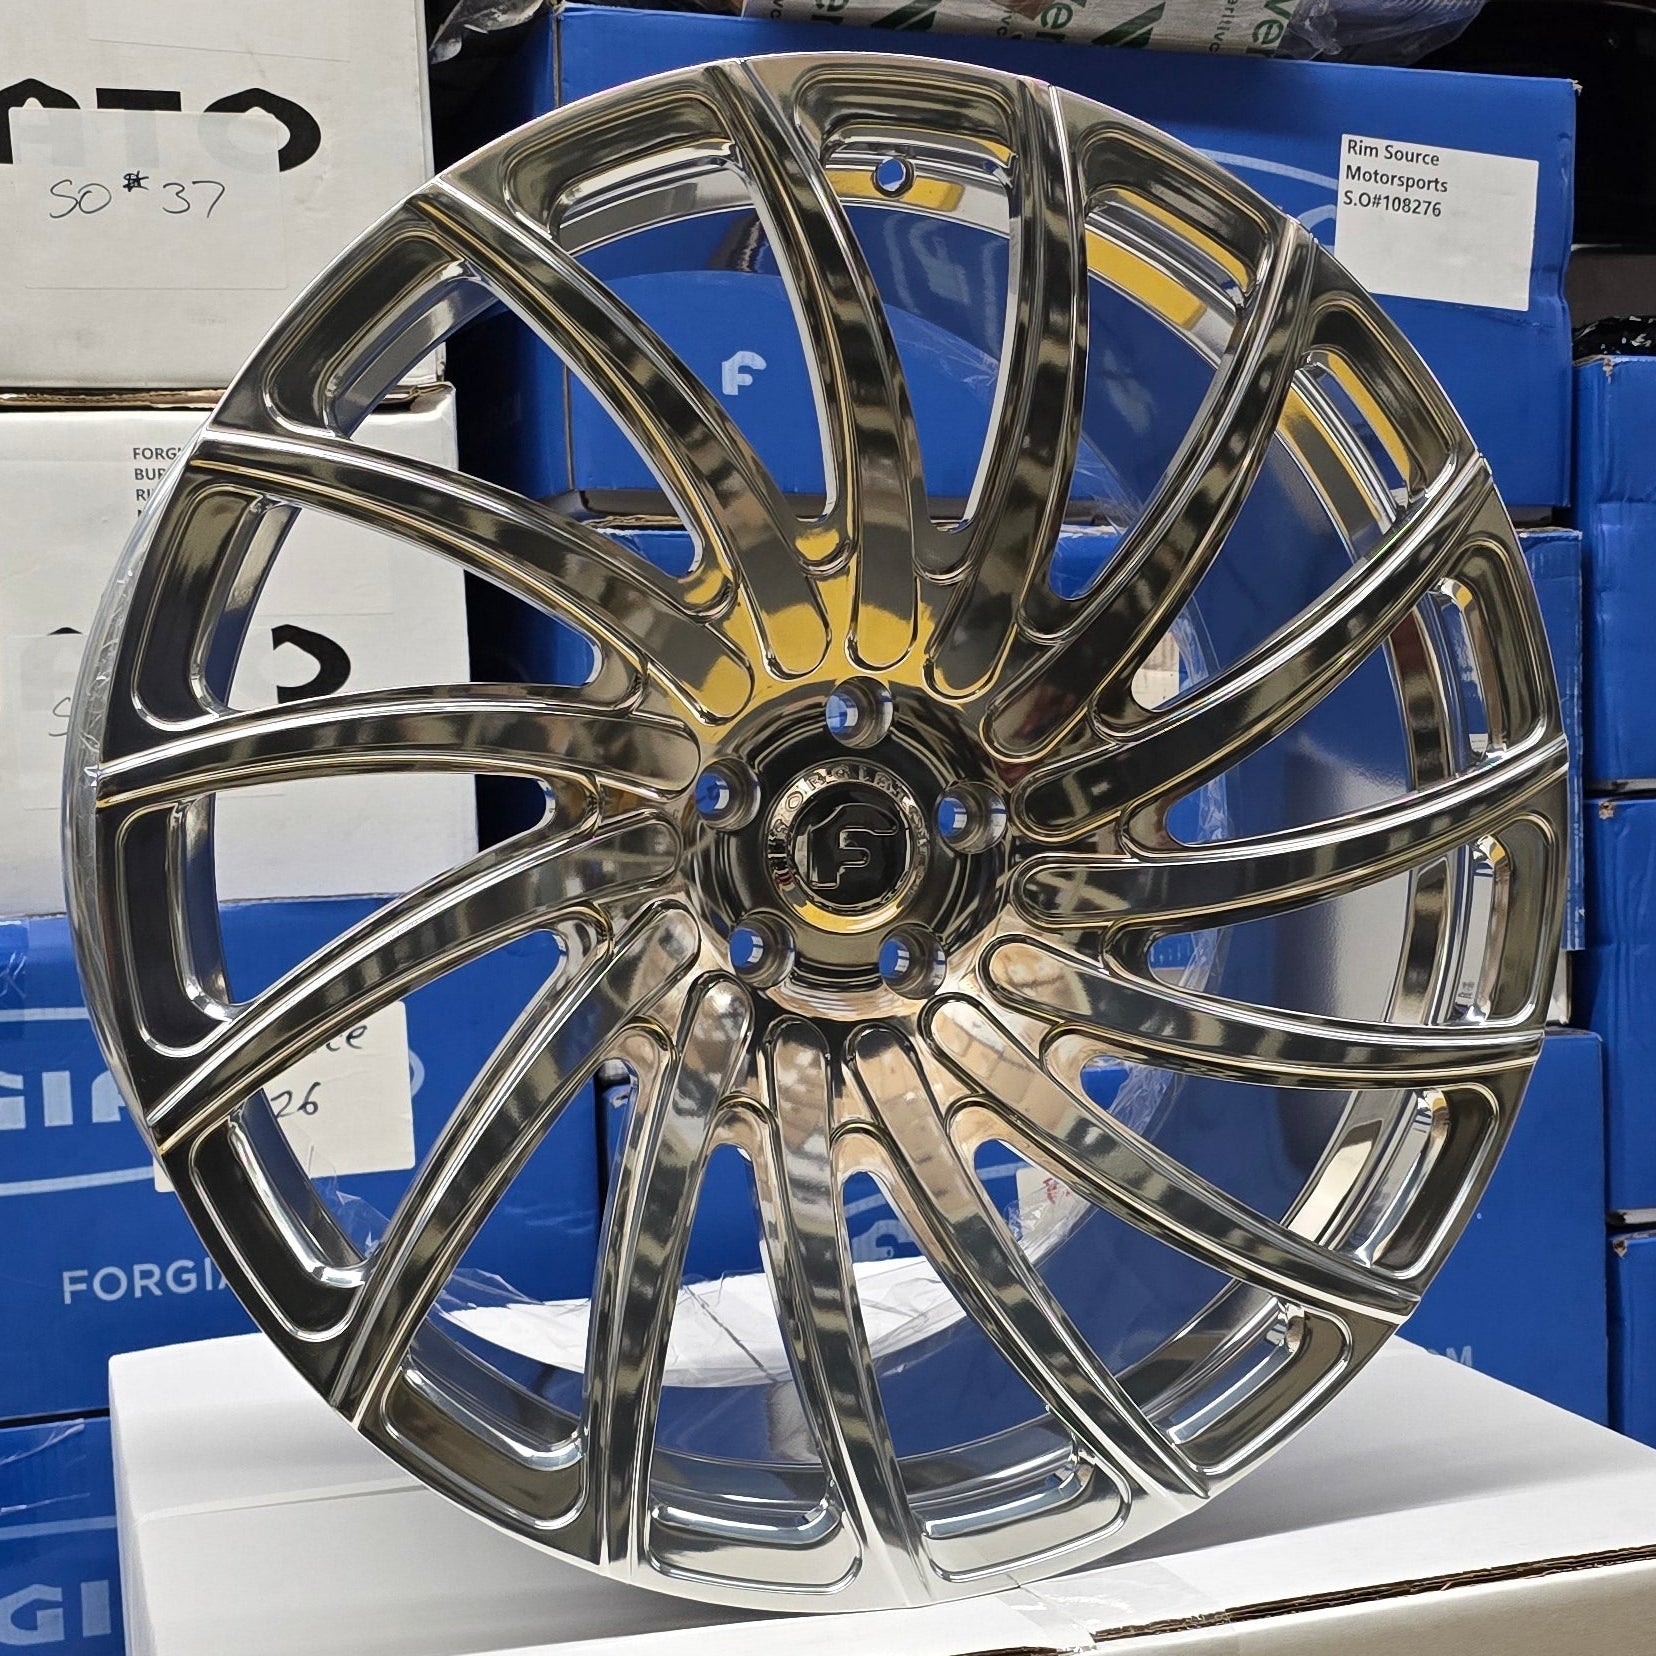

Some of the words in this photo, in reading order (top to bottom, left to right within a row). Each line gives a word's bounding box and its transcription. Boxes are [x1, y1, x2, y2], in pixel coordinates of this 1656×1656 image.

[1347, 138, 1379, 159] Rim
[1383, 144, 1440, 167] Source
[1345, 164, 1448, 193] Motorsports
[50, 179, 112, 218] SO
[162, 180, 225, 218] 37
[1343, 189, 1442, 218] S.O#108276
[62, 1256, 229, 1305] FORGI
